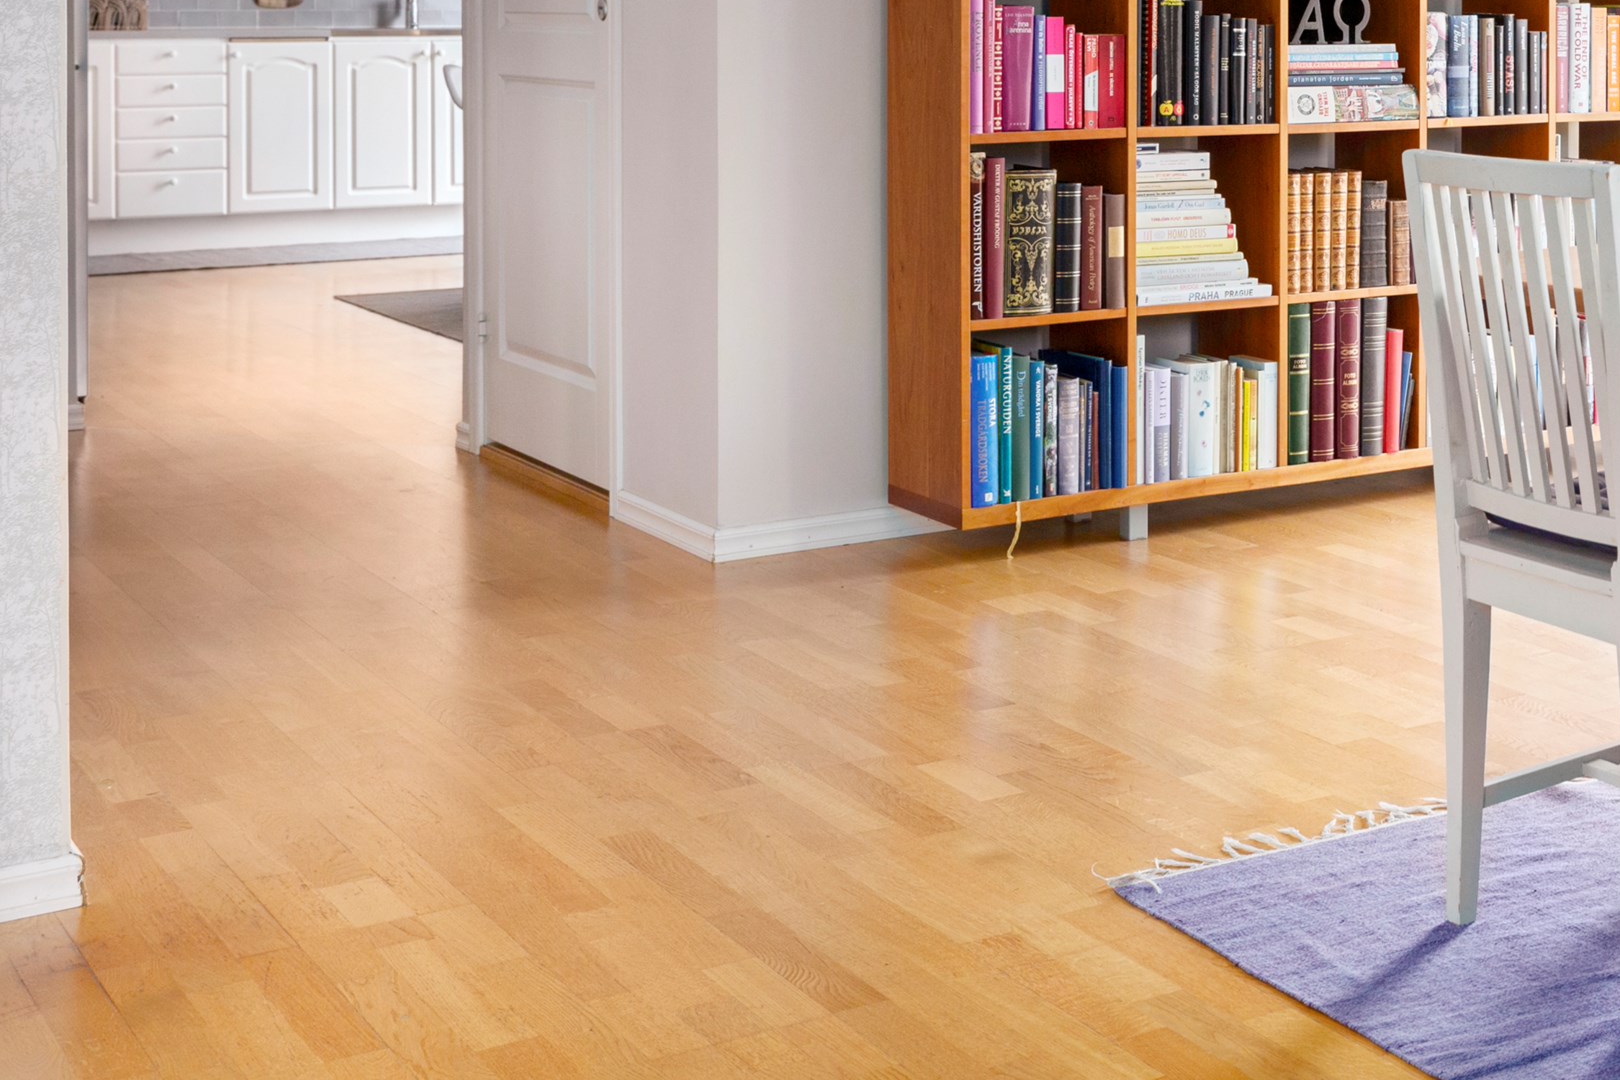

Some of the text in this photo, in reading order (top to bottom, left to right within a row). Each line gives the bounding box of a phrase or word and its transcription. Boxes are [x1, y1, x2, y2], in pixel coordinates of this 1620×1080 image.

[1192, 10, 1200, 31] BODIL
[975, 11, 983, 73] PROVENCE
[1192, 31, 1200, 67] MALMSTEN
[1453, 29, 1461, 52] Berlin
[1574, 7, 1582, 89] THE COLD WAR
[1329, 75, 1354, 83] jorden
[1505, 55, 1514, 94] STASI
[1582, 65, 1588, 80] OF
[1192, 94, 1200, 107] JAG
[994, 186, 1001, 195] AV
[1087, 205, 1096, 235] Anthology
[1167, 227, 1207, 239] HOMO DEUS
[973, 191, 983, 293] VÄRLDSHISTORIEN
[1087, 243, 1096, 271] American
[1087, 271, 1096, 291] Poetry
[1188, 288, 1254, 301] PRAHA PRAGUE
[1003, 354, 1012, 434] NATURGUIDEN
[1016, 370, 1027, 417] Din trädgård
[988, 397, 996, 427] STORA
[977, 399, 989, 483] TRÄDGÅRDSBOKEN
